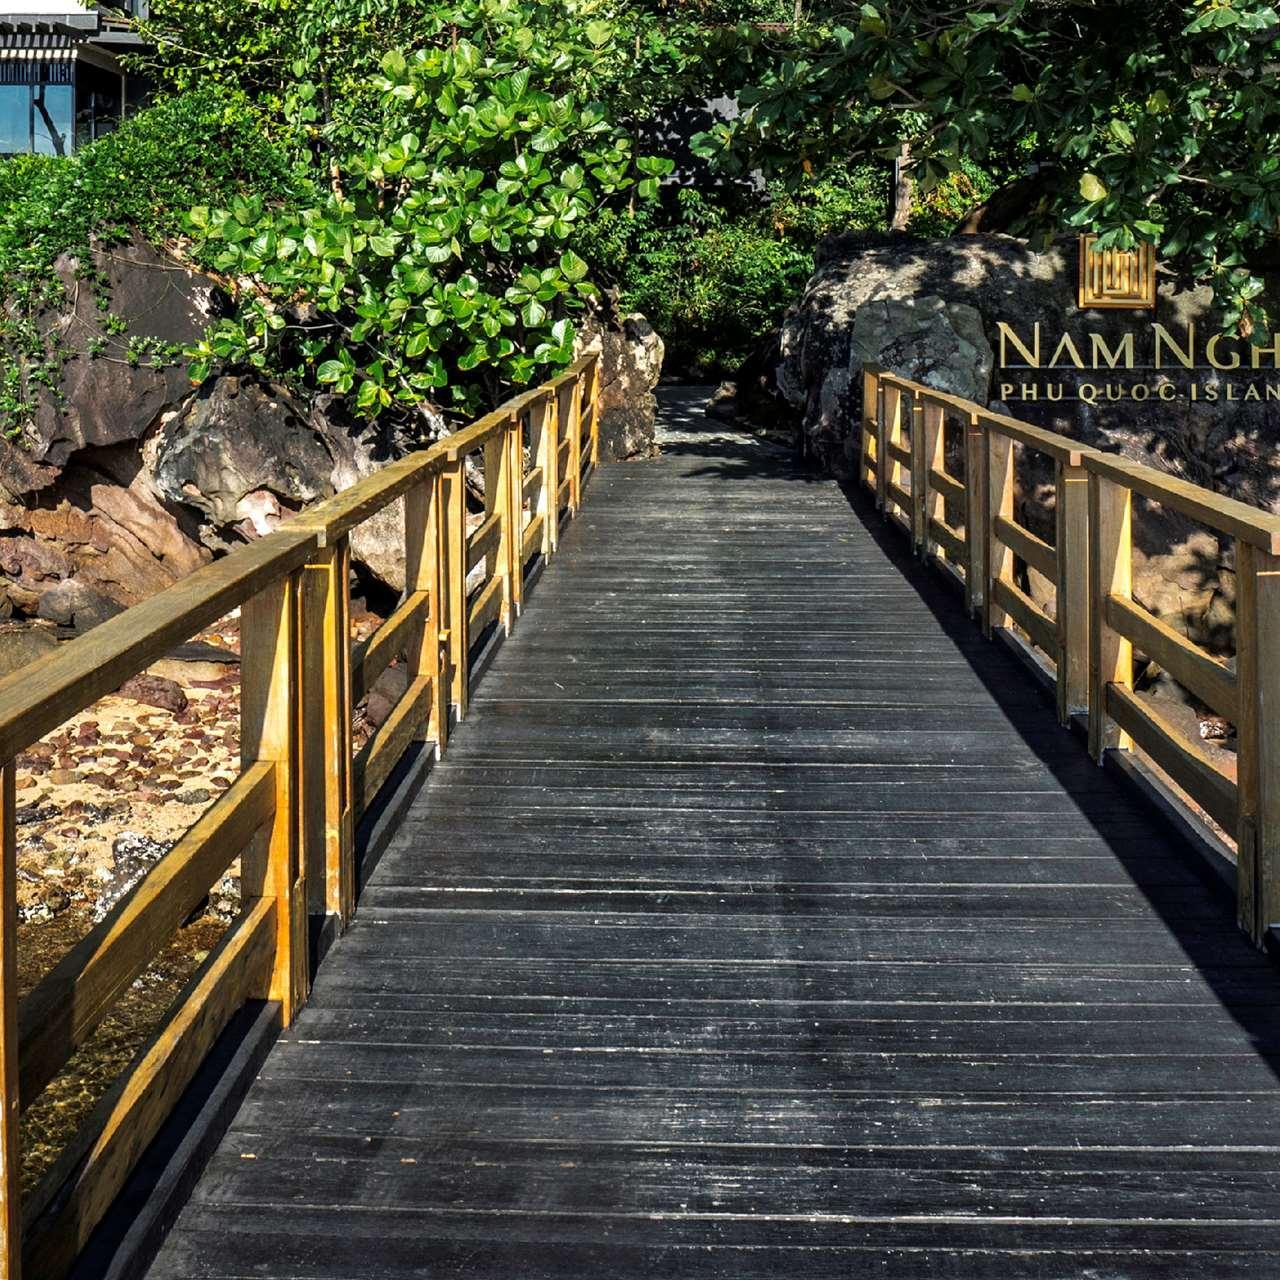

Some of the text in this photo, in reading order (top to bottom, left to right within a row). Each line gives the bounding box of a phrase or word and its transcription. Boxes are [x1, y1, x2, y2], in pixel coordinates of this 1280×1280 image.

[996, 321, 1134, 369] NAM
[1000, 383, 1063, 402] PHU
[1078, 383, 1176, 406] QUOC
